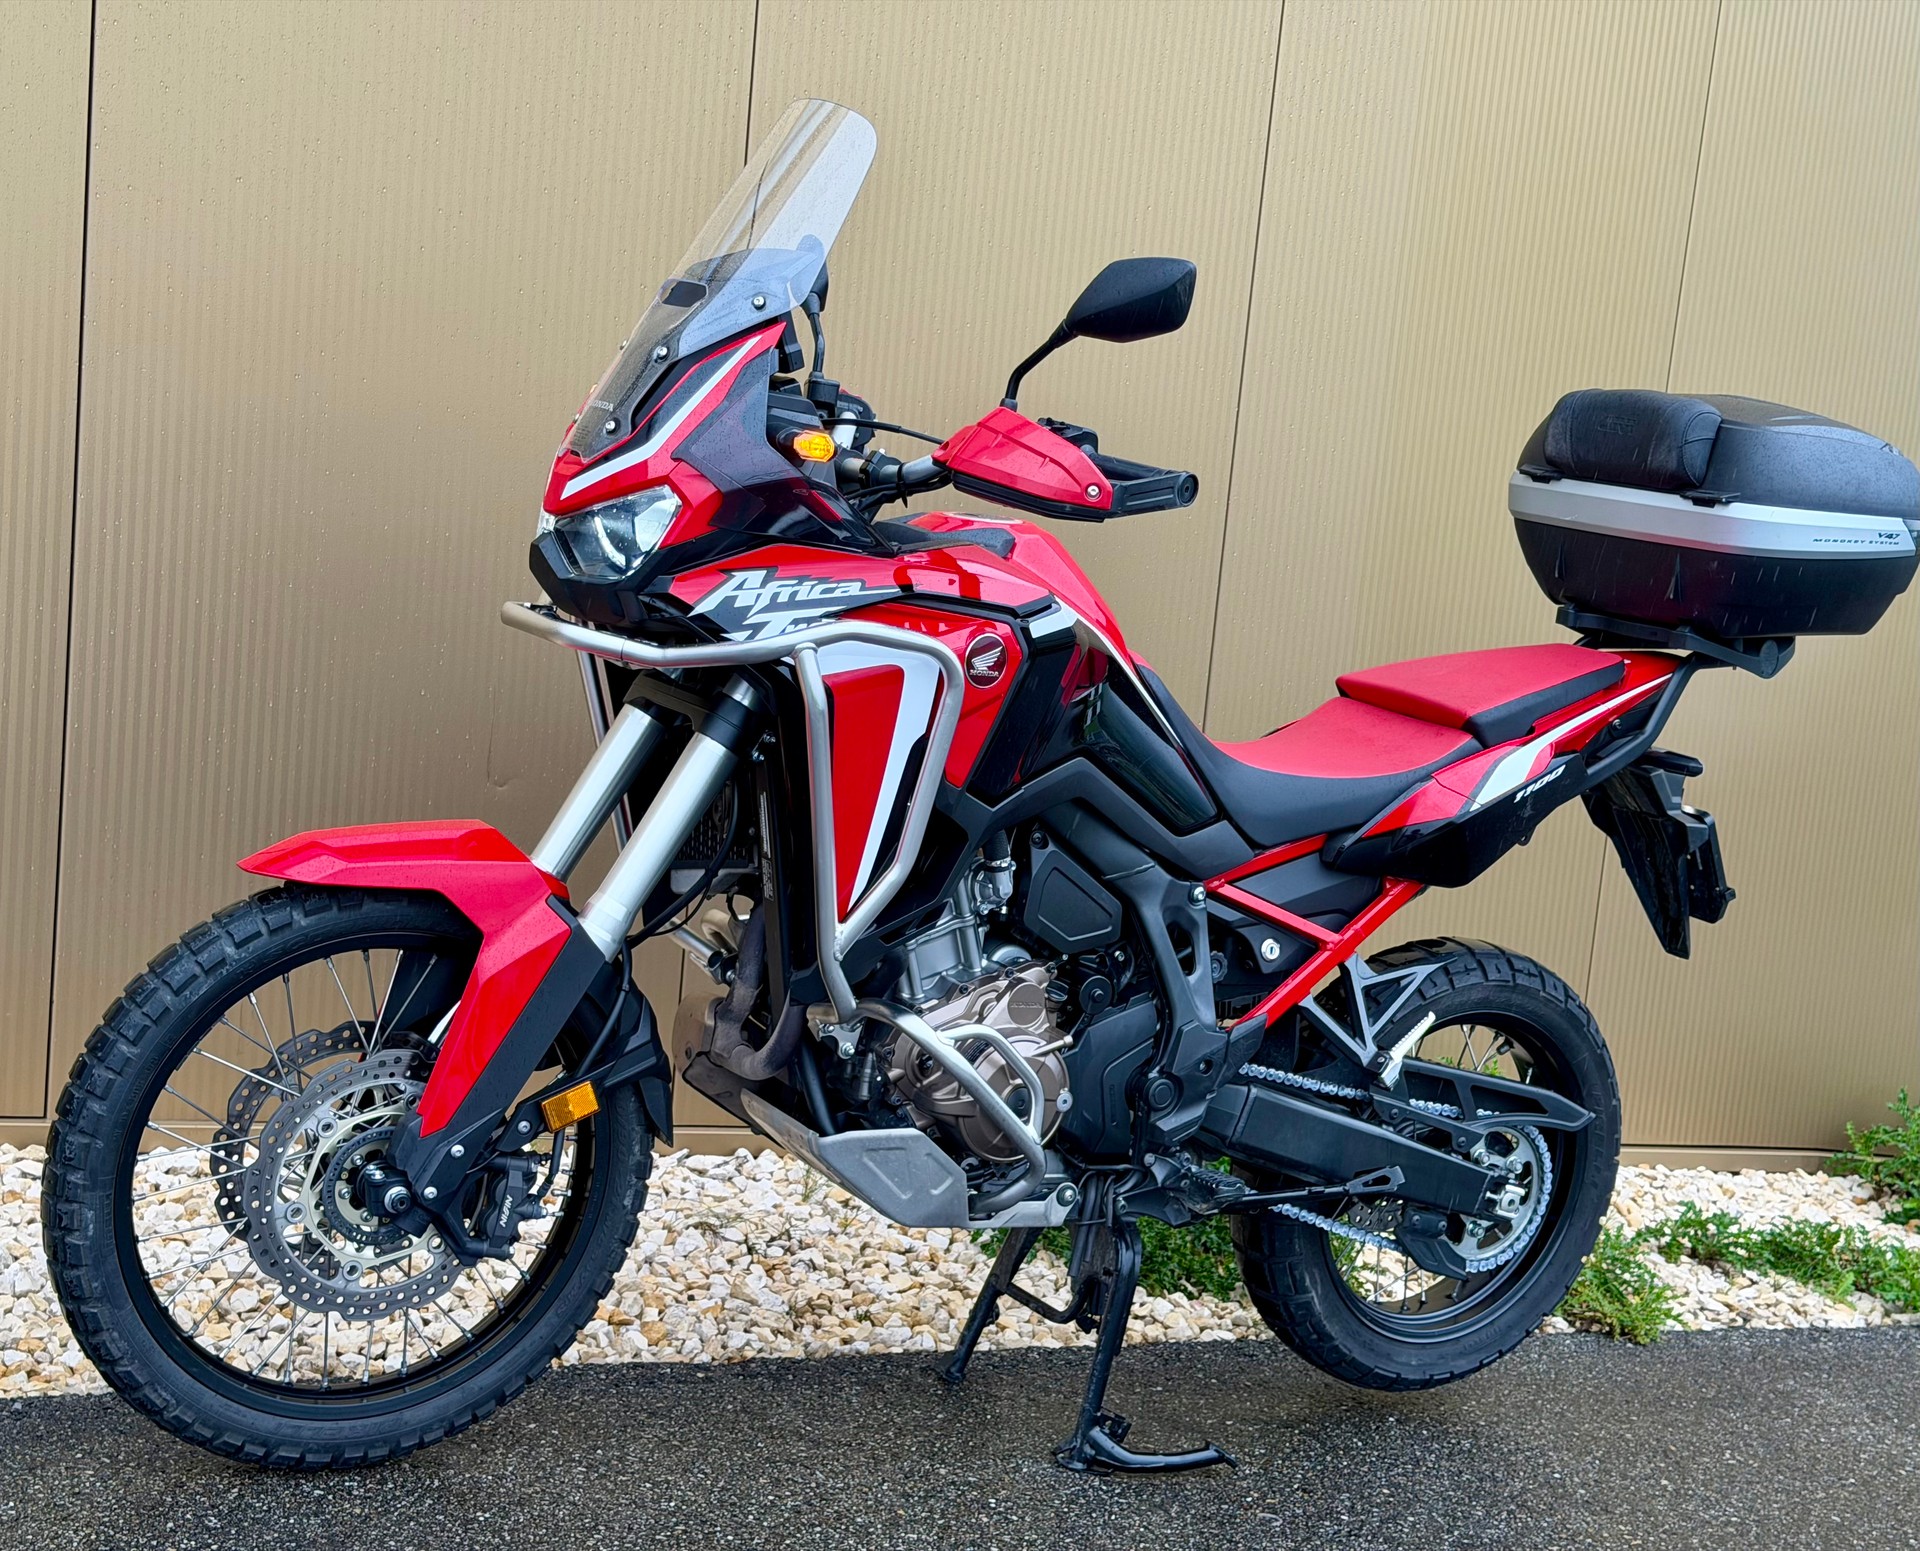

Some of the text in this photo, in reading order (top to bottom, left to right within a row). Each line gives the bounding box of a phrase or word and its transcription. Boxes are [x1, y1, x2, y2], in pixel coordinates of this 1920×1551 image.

[1877, 532, 1901, 540] V47
[687, 569, 901, 618] Africa
[969, 669, 999, 678] HONDA
[1513, 764, 1567, 804] 1100
